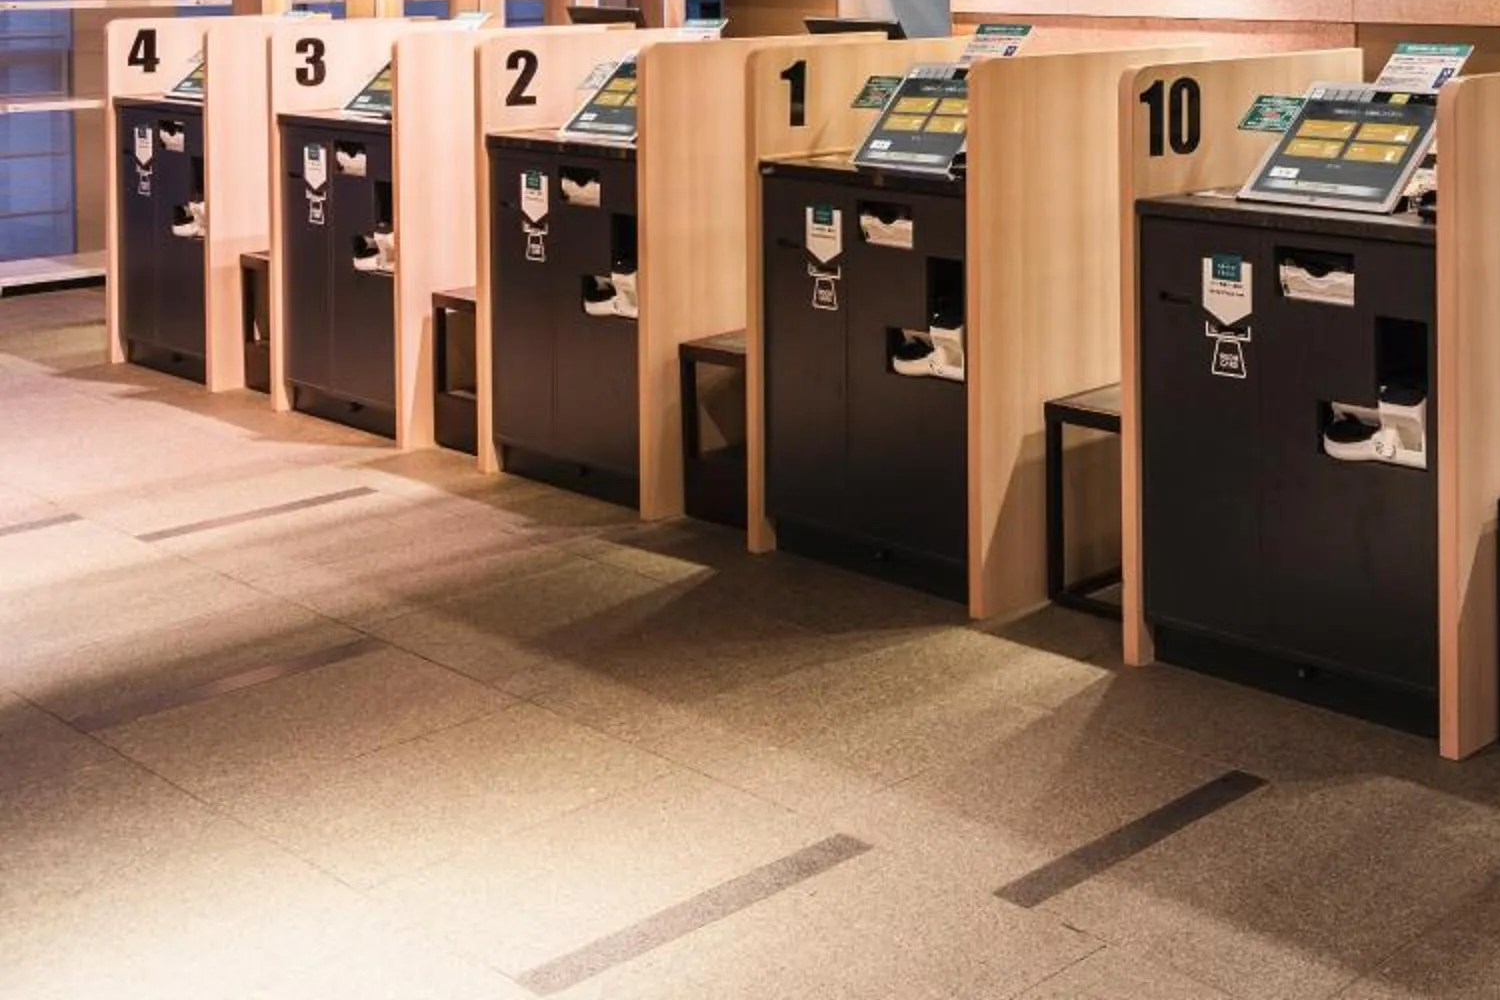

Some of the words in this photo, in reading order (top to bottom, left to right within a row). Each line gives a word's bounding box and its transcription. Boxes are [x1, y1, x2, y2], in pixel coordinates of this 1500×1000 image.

[127, 28, 161, 73] 4
[295, 37, 327, 87] 3
[505, 50, 539, 107] 2
[780, 60, 807, 127] 1
[1140, 77, 1201, 156] 10
